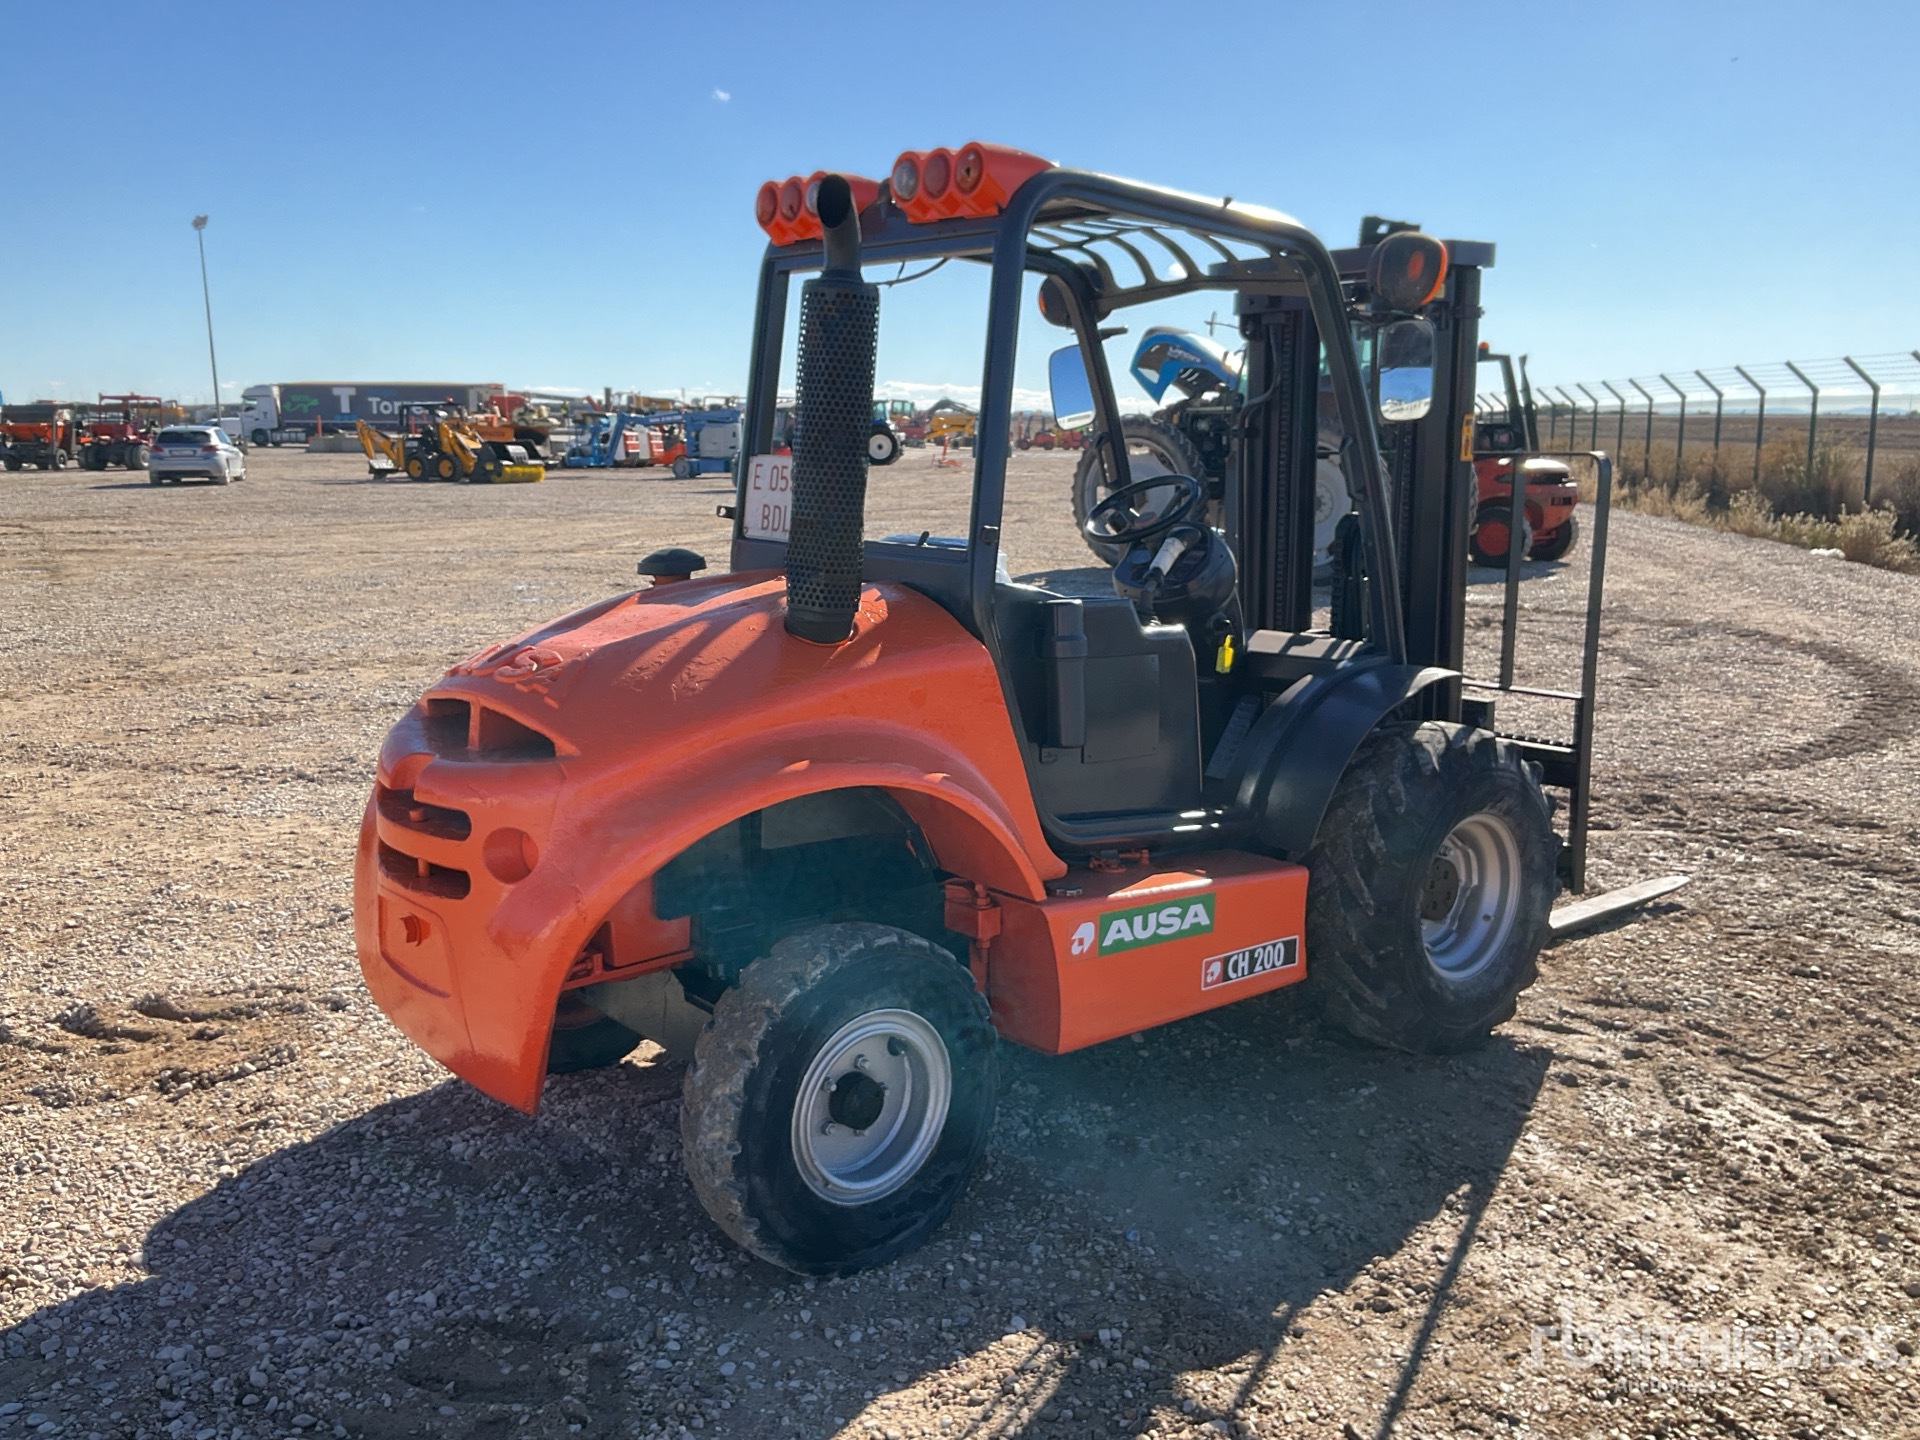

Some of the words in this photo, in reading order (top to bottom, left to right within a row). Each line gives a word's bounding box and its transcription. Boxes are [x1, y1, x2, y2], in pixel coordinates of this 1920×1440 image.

[753, 463, 764, 490] E
[769, 465, 793, 492] 05
[761, 503, 790, 532] BDL
[1102, 903, 1211, 947] AUSA
[1227, 948, 1249, 980] CH
[1254, 941, 1285, 973] 200
